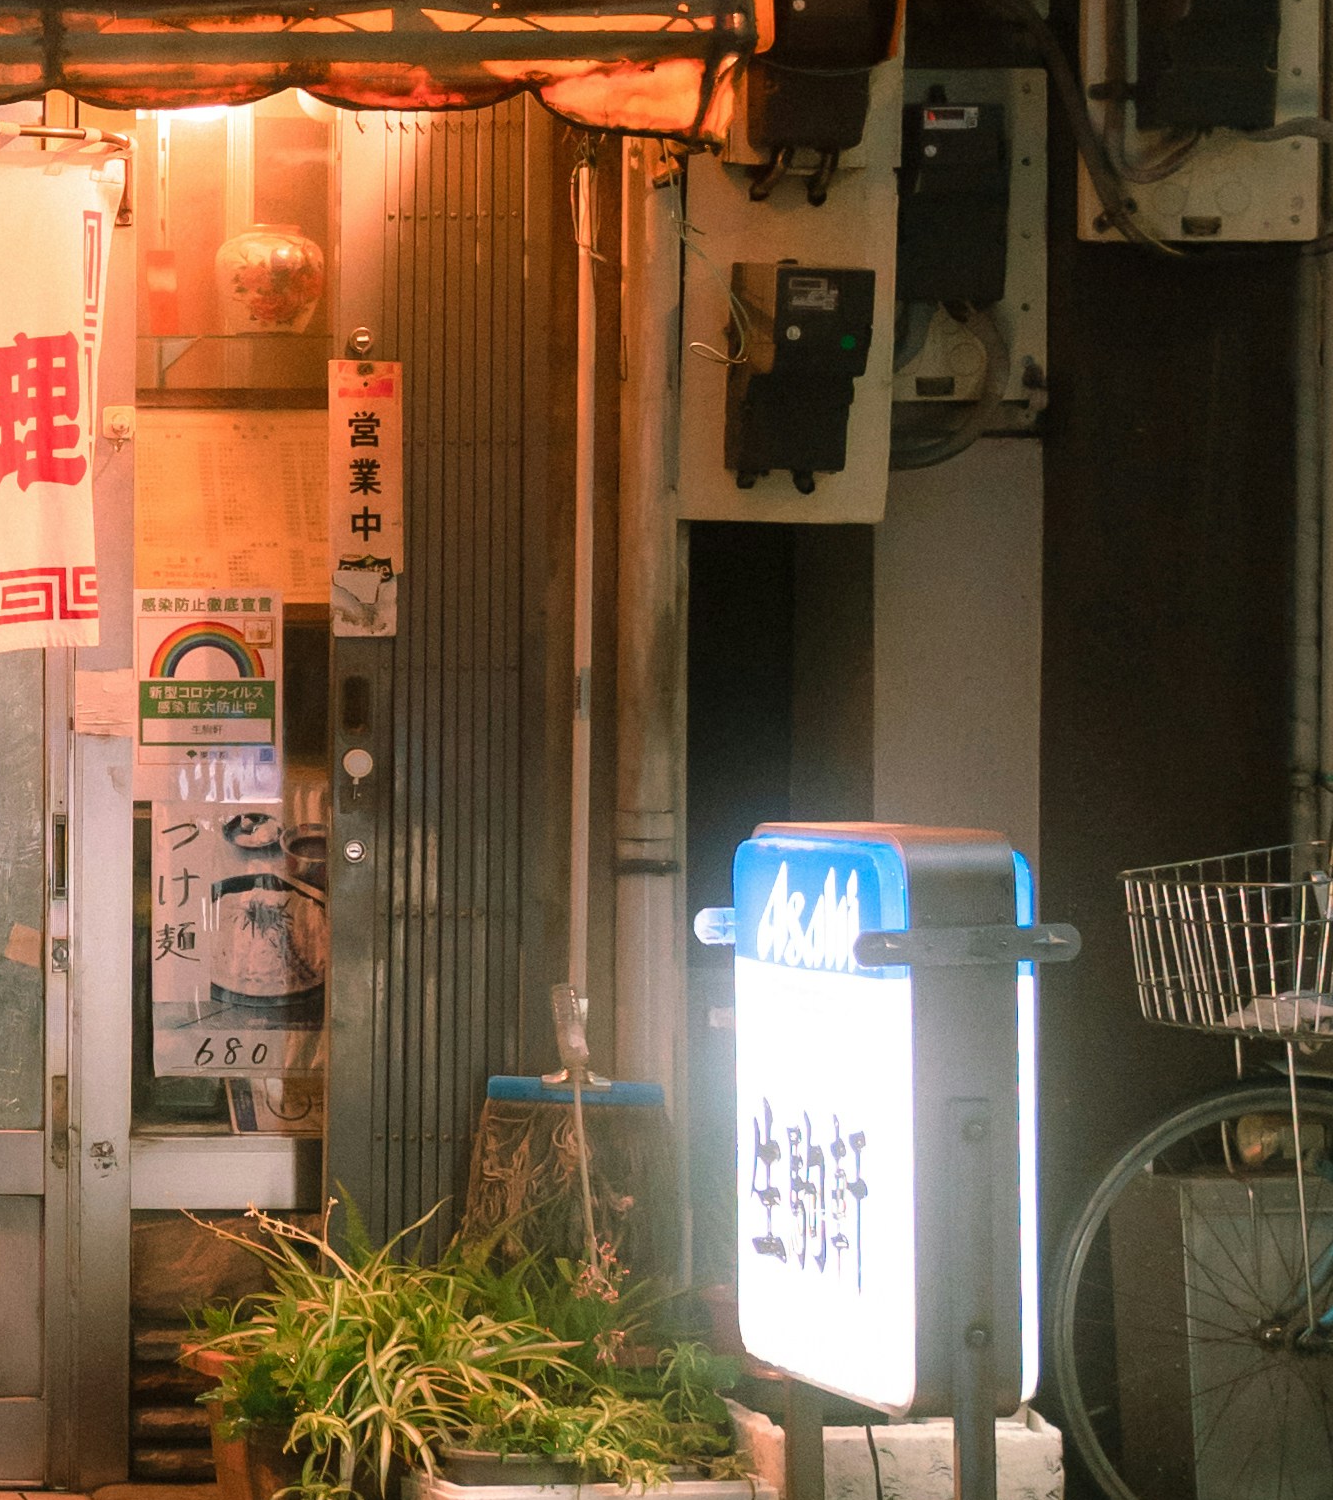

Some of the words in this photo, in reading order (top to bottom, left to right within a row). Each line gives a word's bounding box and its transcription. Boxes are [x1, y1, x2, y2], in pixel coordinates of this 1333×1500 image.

[347, 411, 383, 542] 営業中
[141, 596, 273, 614] 感染防止徹底宣言
[148, 685, 266, 700] 新型コロナウイルス
[156, 700, 258, 715] 感染拡大防止中
[155, 821, 201, 963] つけ麺
[756, 860, 861, 974] Asahi
[194, 1036, 269, 1066] 680
[749, 1095, 870, 1296] 生駒軒
